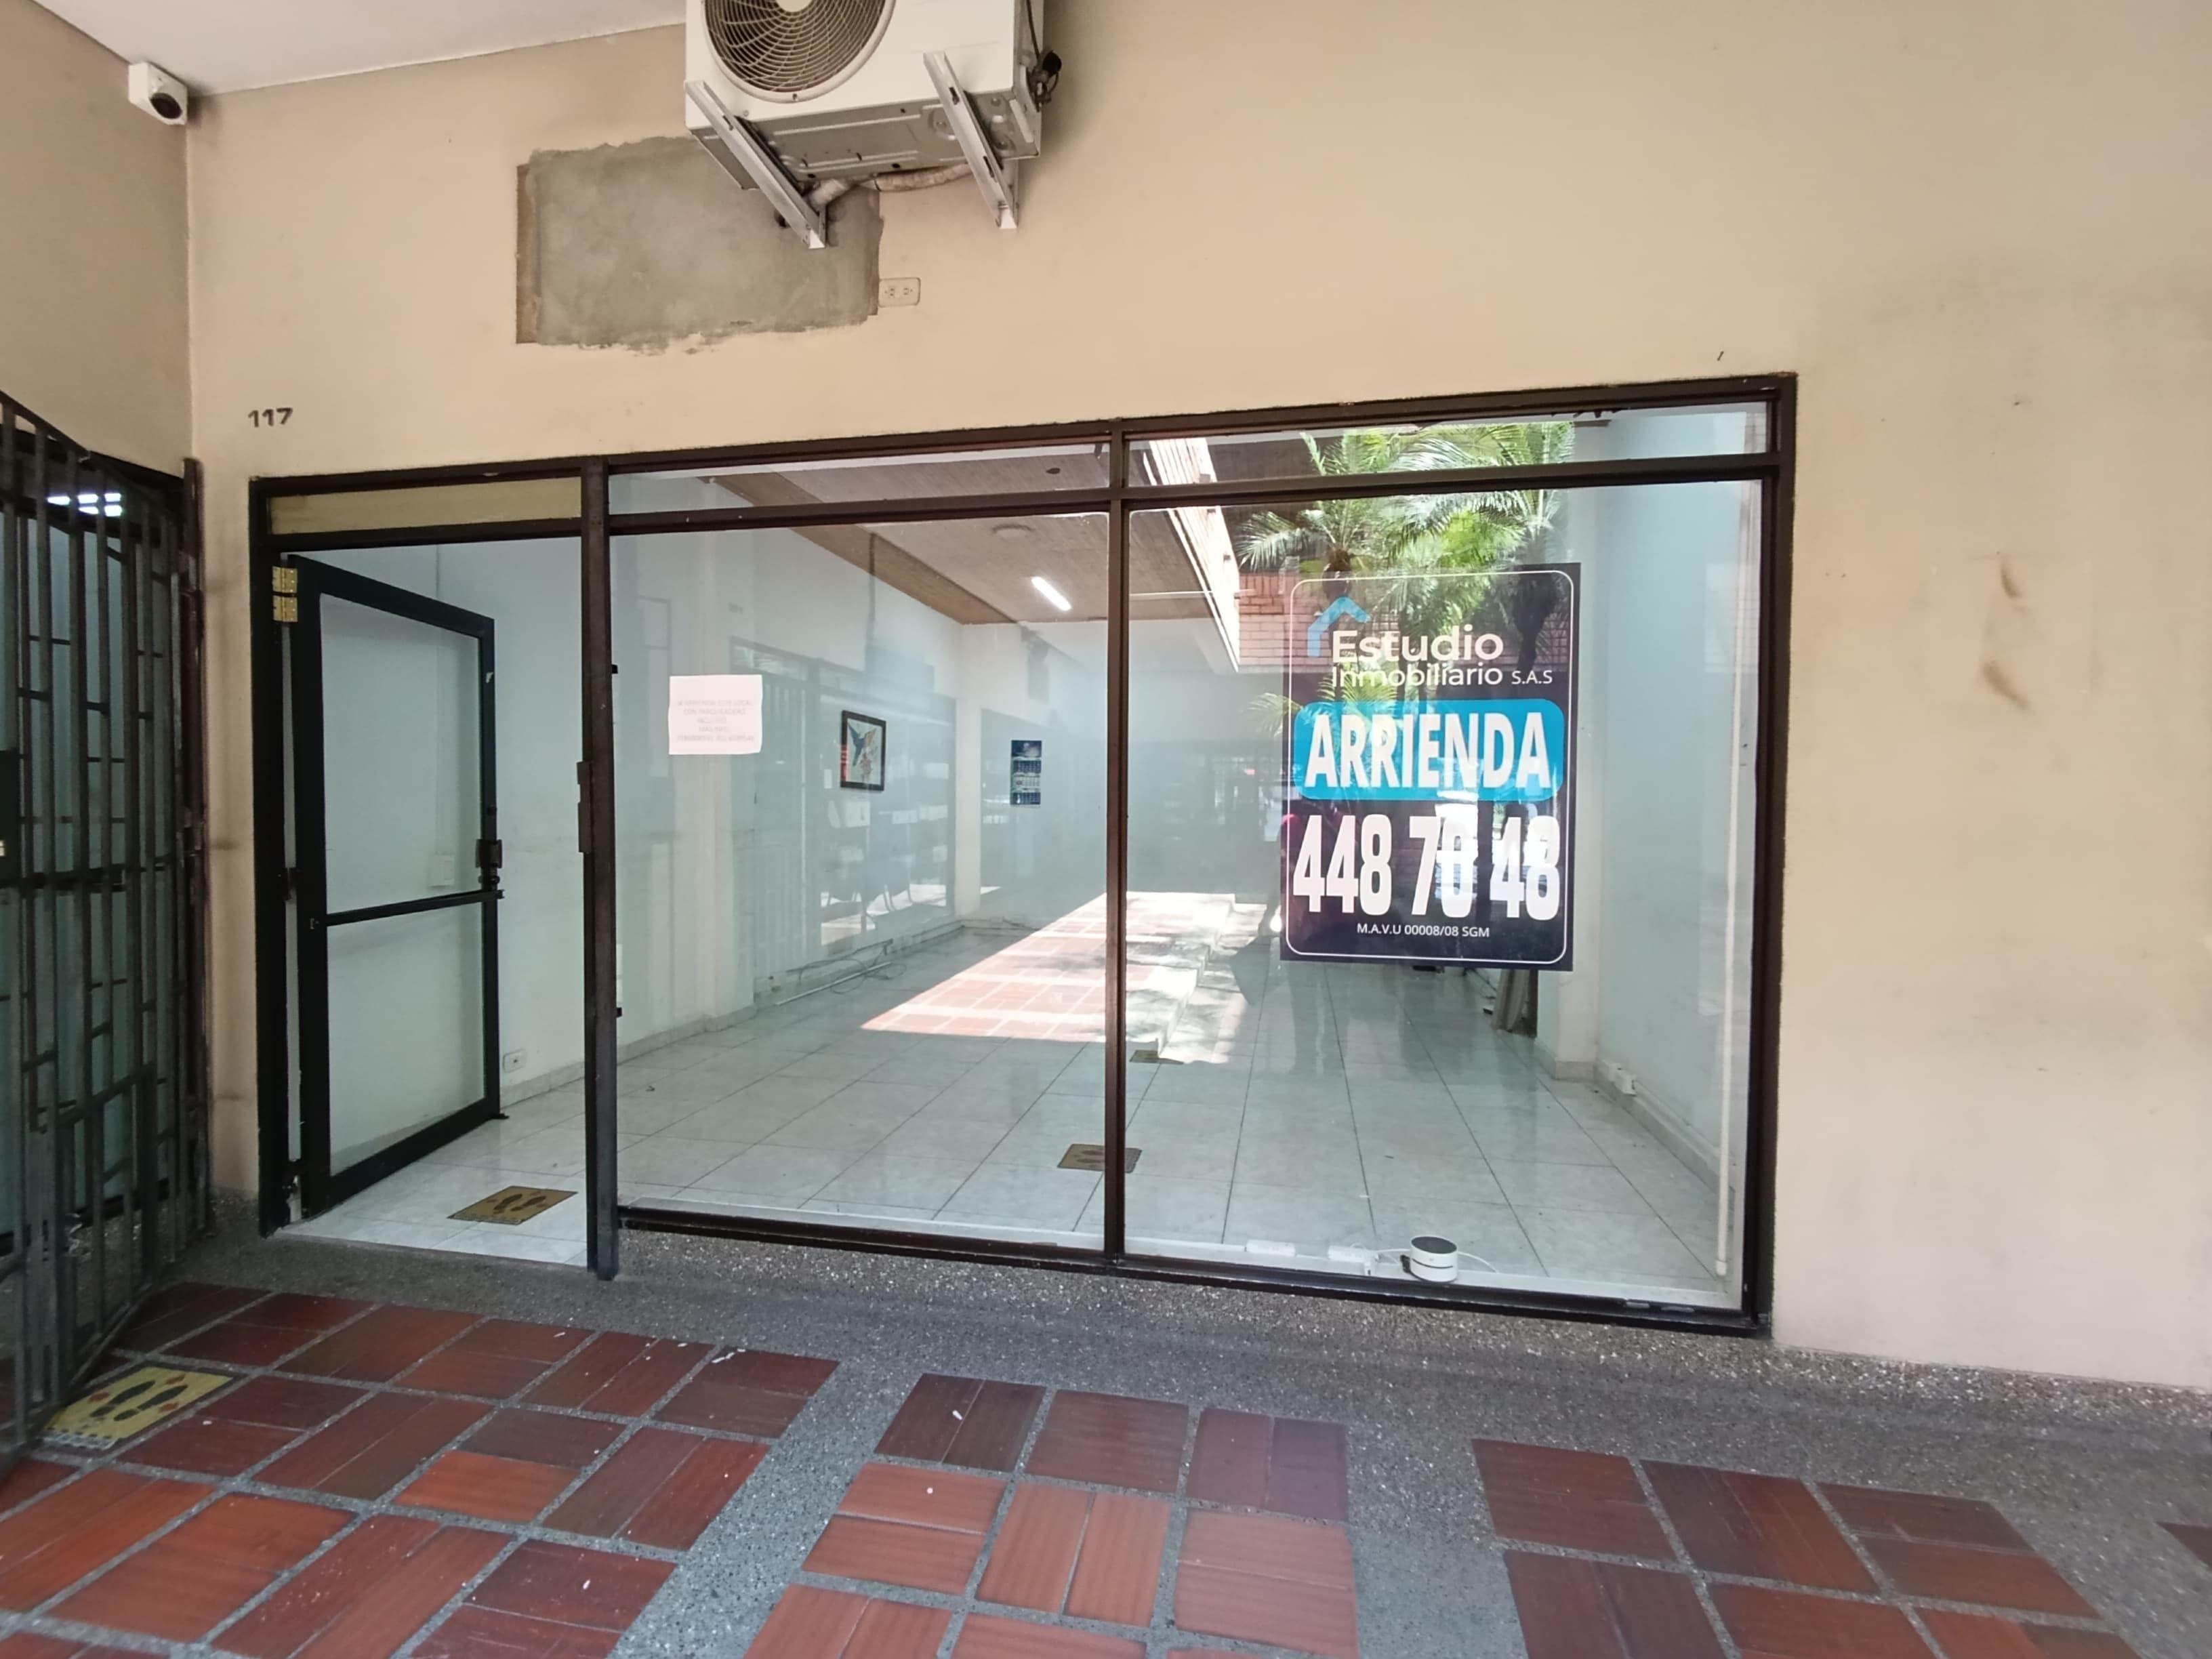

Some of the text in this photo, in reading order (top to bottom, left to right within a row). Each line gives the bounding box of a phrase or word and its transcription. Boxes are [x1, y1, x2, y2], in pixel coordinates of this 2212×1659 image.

[247, 407, 293, 428] 117
[1332, 623, 1504, 663] Estudio
[1332, 661, 1553, 688] Inmobiliario S.A.S
[1305, 712, 1552, 789] ARRIENDA
[1292, 813, 1393, 916] 448
[1489, 815, 1560, 920] 48
[1357, 923, 1490, 938] M.A.V.U 00008/08 SGM
